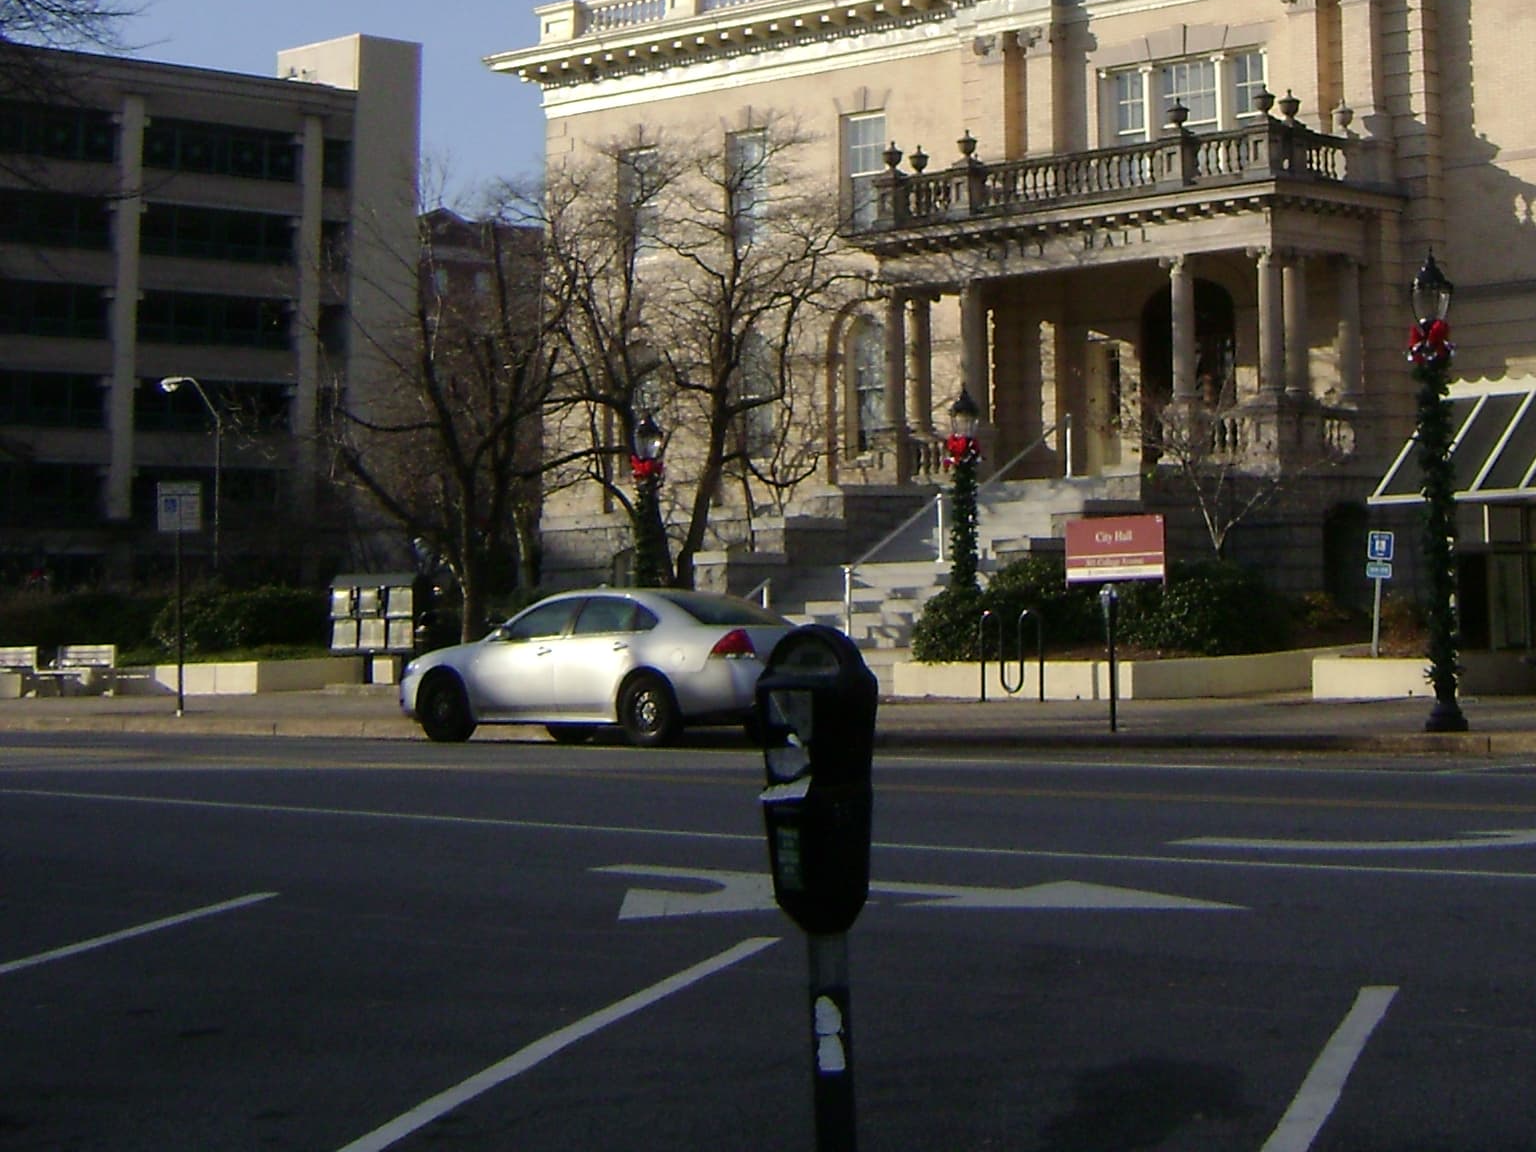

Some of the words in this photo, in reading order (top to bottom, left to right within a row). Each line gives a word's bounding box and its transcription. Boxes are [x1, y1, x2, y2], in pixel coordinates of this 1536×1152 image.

[1083, 228, 1150, 250] HALL
[1095, 531, 1113, 545] City
[1114, 530, 1132, 542] Hall
